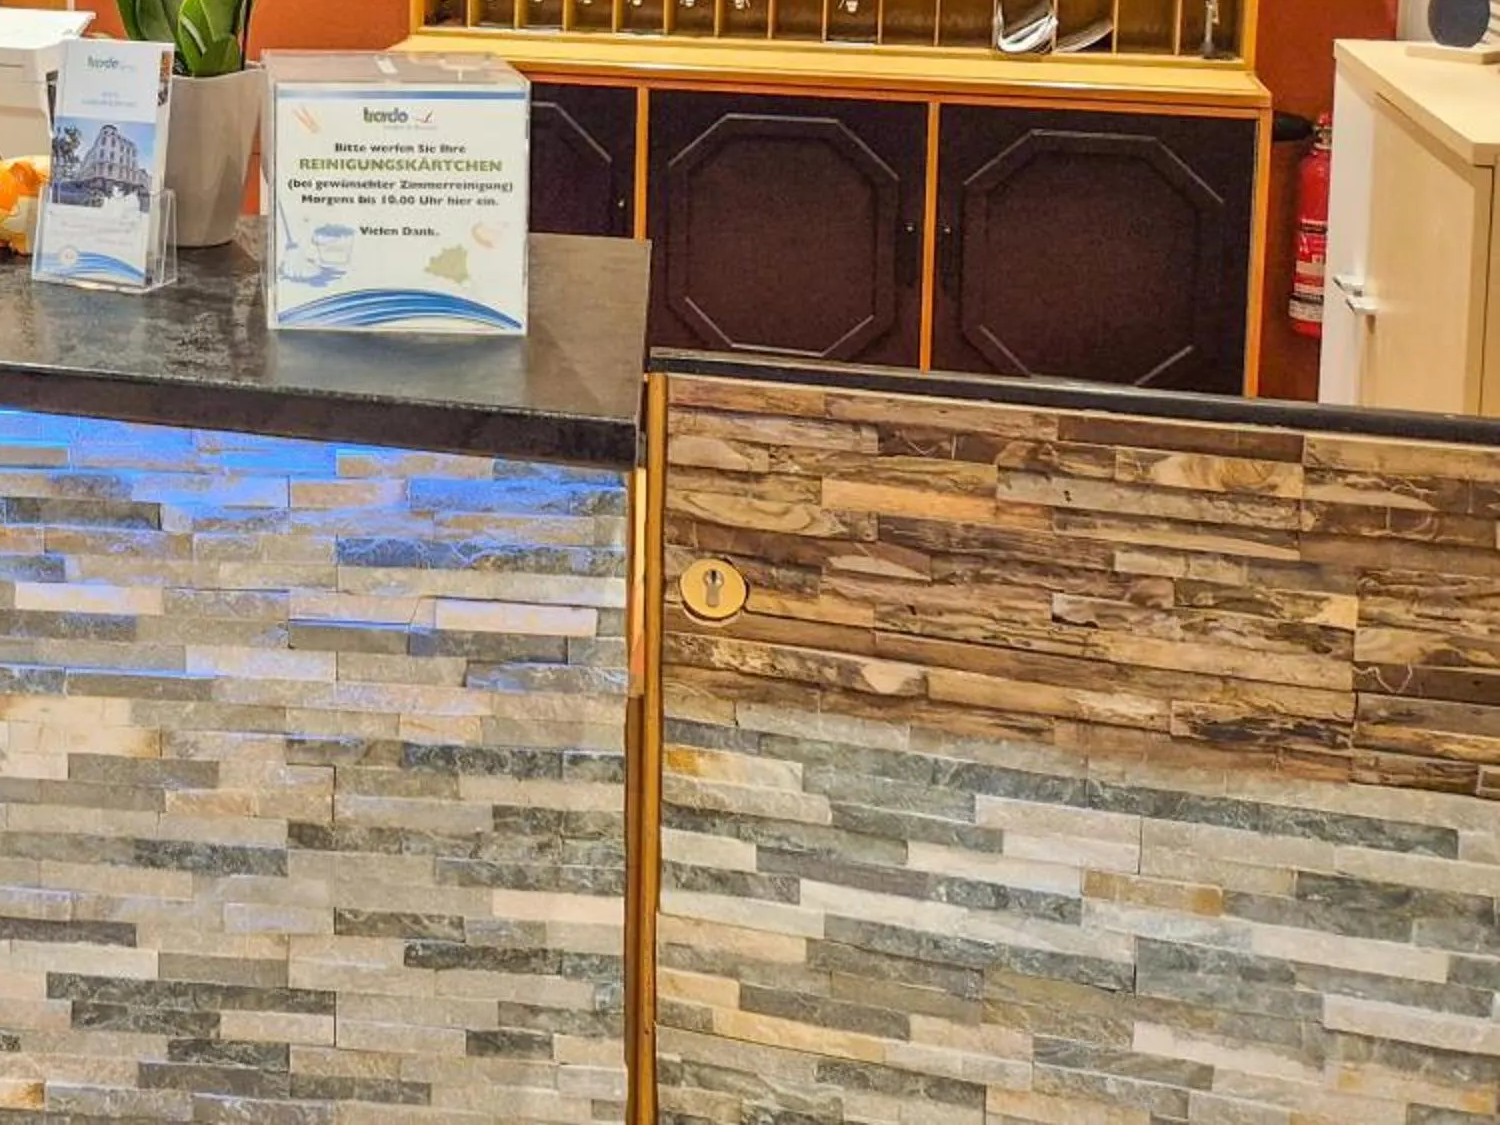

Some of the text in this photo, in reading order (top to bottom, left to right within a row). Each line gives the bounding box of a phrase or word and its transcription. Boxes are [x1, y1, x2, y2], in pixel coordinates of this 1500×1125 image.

[334, 142, 467, 155] Bitte werfen Sie Ihre
[298, 155, 503, 173] REINIGUNGSKÄRTCHEN
[287, 178, 514, 193] (bei gewünschter Zimmerreinigung)
[301, 194, 499, 207] Morgens bis 10.00 Uhr hier ein.
[359, 225, 441, 238] Vielen Dank.
